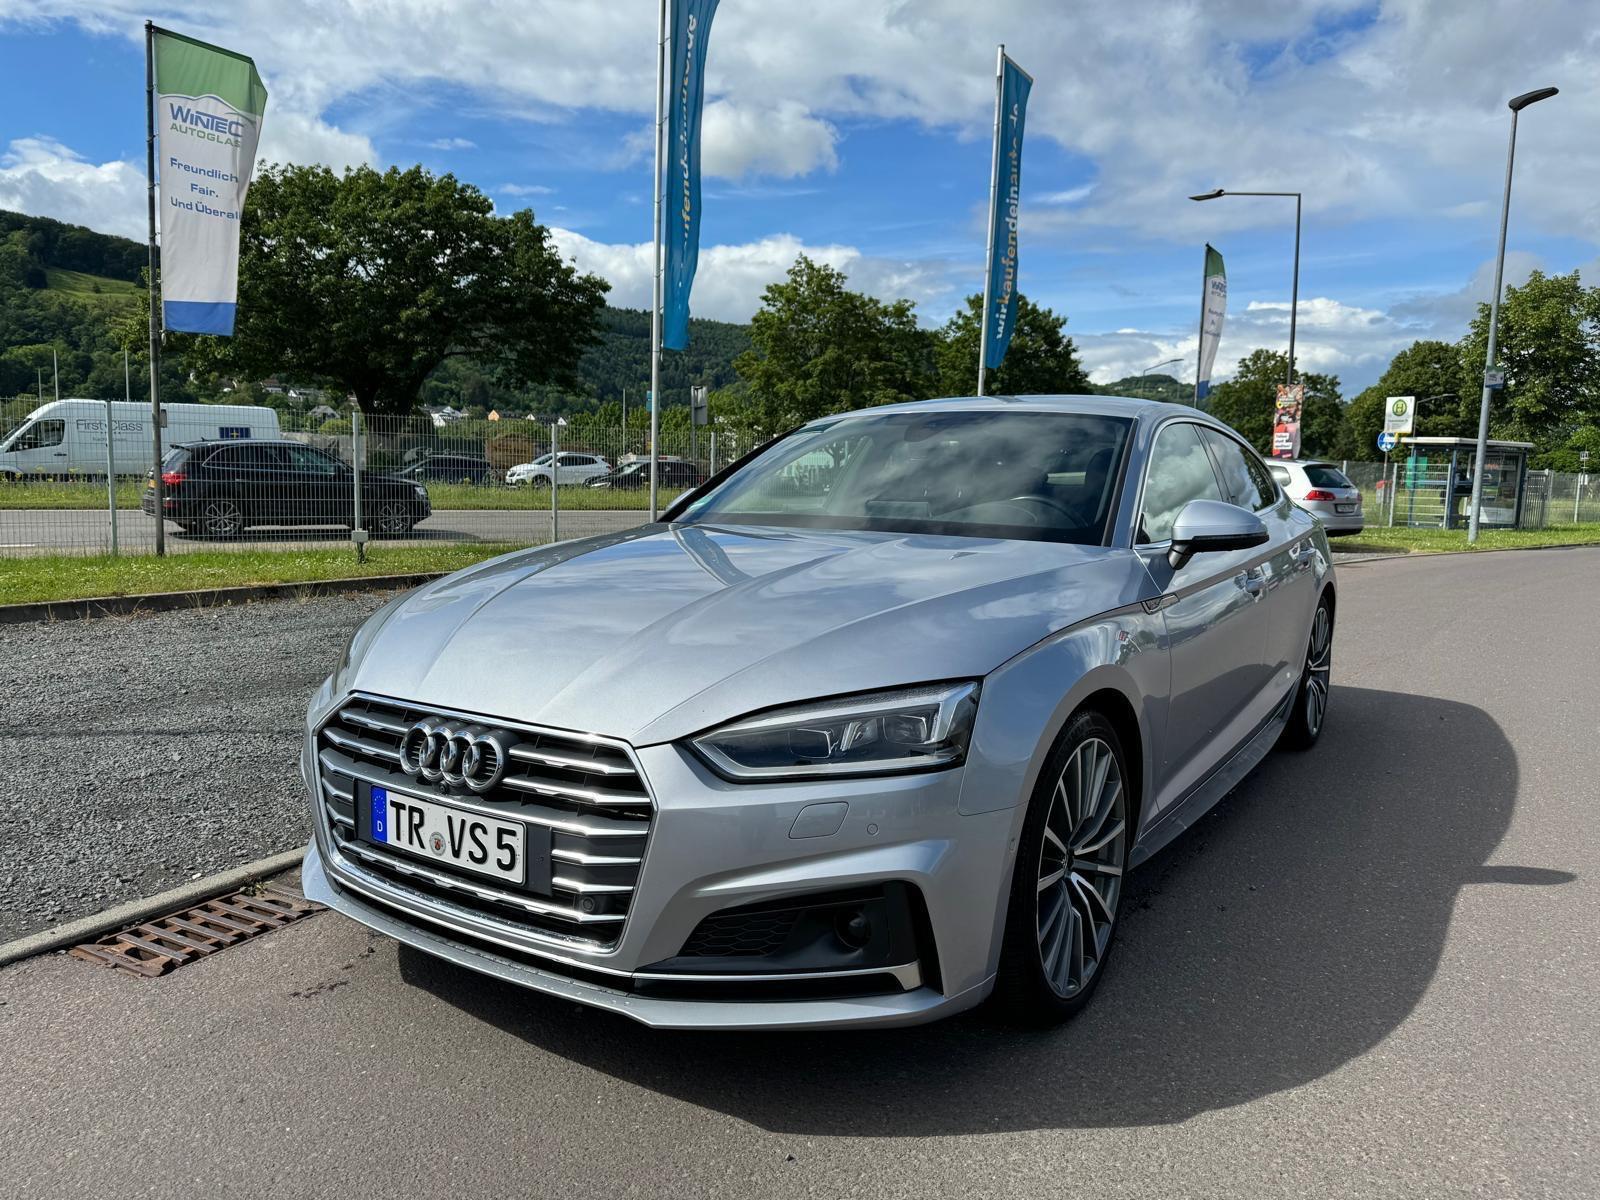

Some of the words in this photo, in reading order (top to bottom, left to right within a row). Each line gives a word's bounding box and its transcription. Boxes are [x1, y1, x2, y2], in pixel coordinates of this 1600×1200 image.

[169, 122, 242, 148] AUTOGLAS
[169, 157, 239, 184] Freundlich
[190, 183, 219, 198] Fair.
[170, 196, 193, 211] Und
[76, 418, 104, 431] First
[377, 820, 384, 832] D
[389, 800, 426, 849] TR
[447, 815, 488, 864] VS
[496, 826, 517, 872] 5
